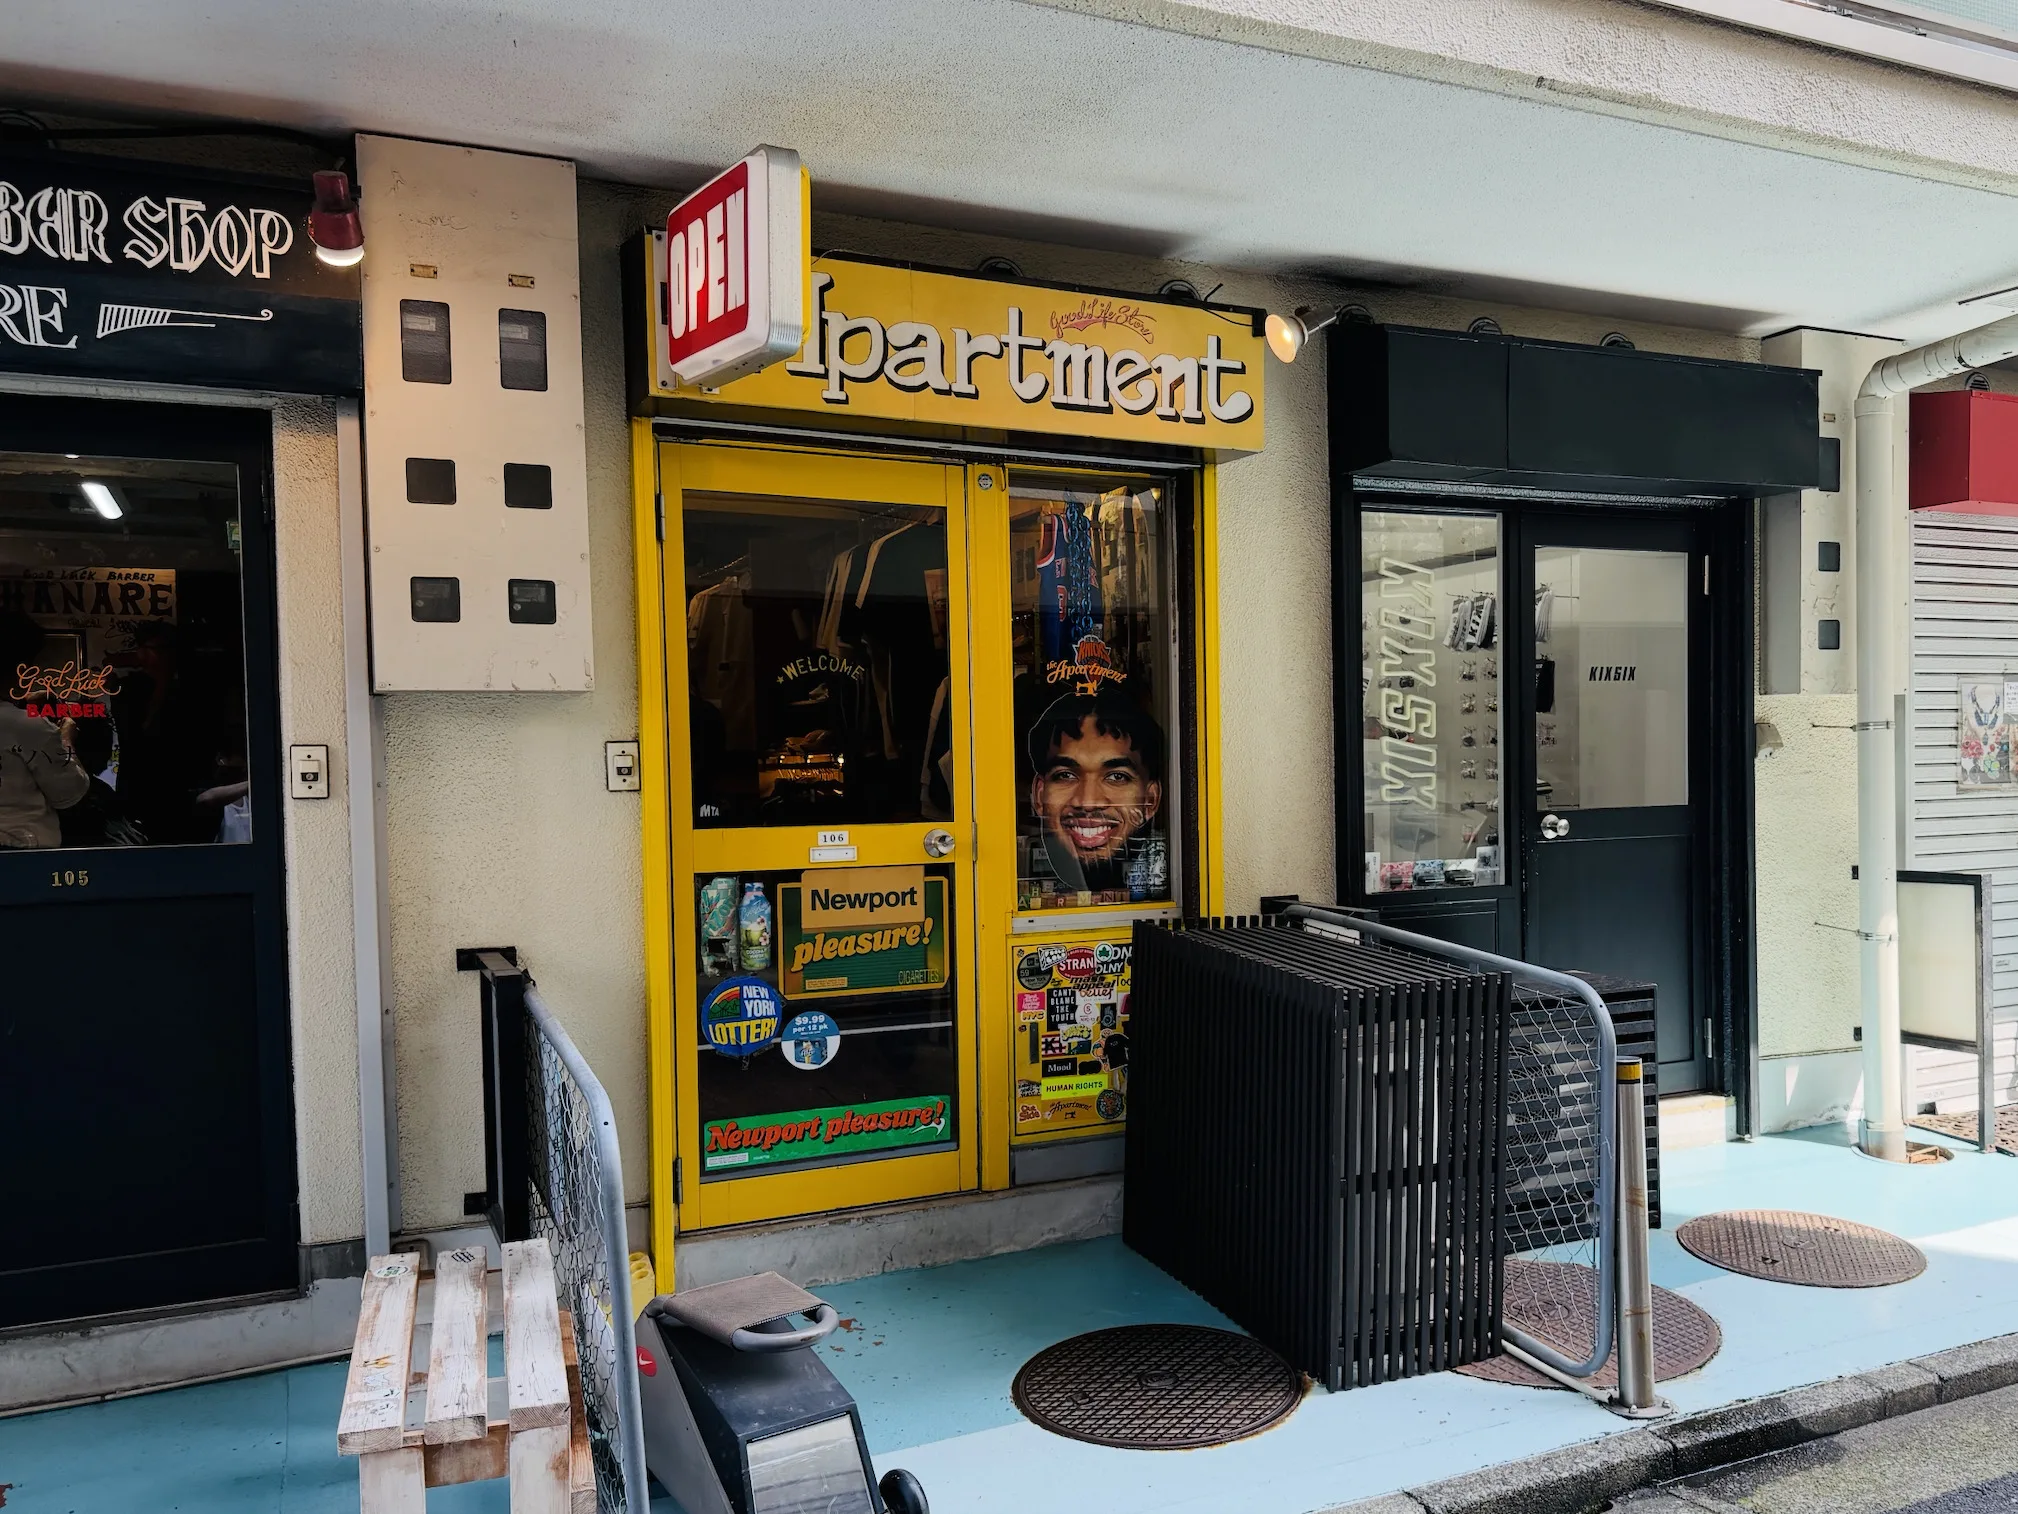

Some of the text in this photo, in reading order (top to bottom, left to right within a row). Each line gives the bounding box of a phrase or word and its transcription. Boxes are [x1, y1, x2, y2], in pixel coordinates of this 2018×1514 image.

[670, 186, 745, 340] OPEN
[1050, 299, 1087, 338] Good
[1078, 641, 1111, 664] KNICKS
[782, 654, 867, 681] WELCOME
[1047, 660, 1127, 683] Apartment
[1589, 666, 1636, 681] KIXSIX
[10, 661, 74, 700] Good
[1379, 556, 1437, 811] KIXSIX
[26, 703, 106, 718] BARBER
[700, 803, 720, 818] MTA
[823, 834, 844, 843] 106
[51, 870, 89, 887] 105
[811, 887, 917, 912] Newport
[790, 917, 934, 972] pleasure!
[1060, 957, 1097, 971] STRAN
[898, 968, 939, 985] CIGARETTES
[743, 985, 769, 999] NEW
[1052, 989, 1072, 997] CANT
[1050, 996, 1075, 1005] BLAME
[1055, 1004, 1069, 1013] THE
[744, 1000, 776, 1018] YORK
[794, 1015, 825, 1026] $9.99
[1050, 1013, 1075, 1022] YOUTH
[708, 1017, 778, 1046] LOTTERY
[792, 1025, 806, 1034] per
[819, 1023, 829, 1031] pk
[1047, 1063, 1072, 1073] Mood
[1046, 1083, 1074, 1092] HUMAN
[1075, 1081, 1103, 1090] RIGHTS
[706, 1100, 945, 1151] Newport pleasure!
